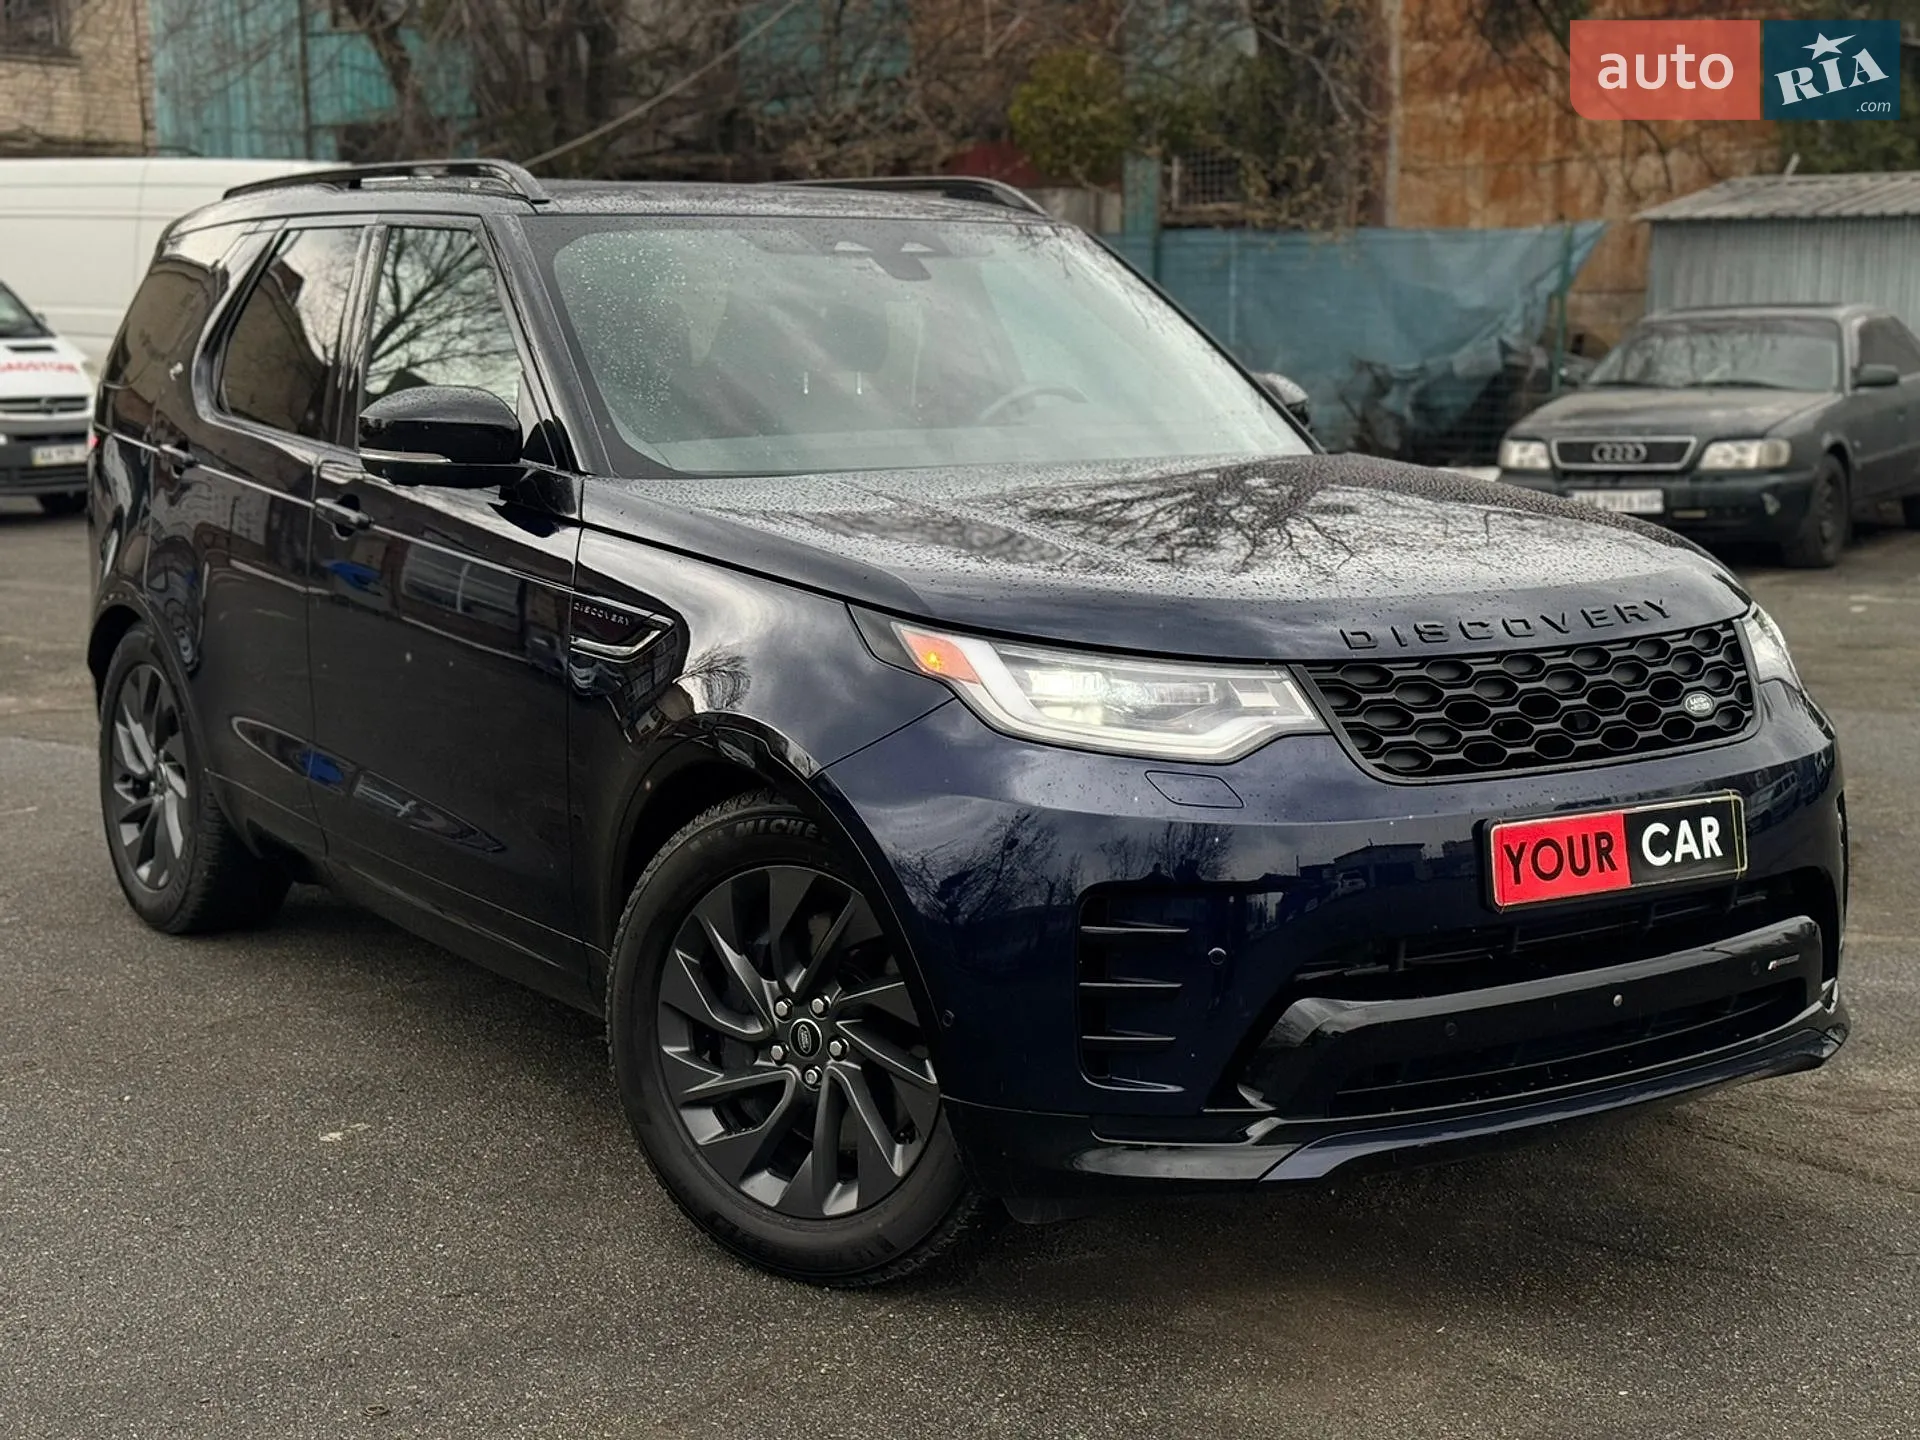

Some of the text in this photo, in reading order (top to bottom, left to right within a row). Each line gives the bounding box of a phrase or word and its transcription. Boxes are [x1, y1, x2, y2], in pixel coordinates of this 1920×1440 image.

[1339, 599, 1671, 650] DISCOVERY
[1503, 816, 1723, 886] YOUR CAR
